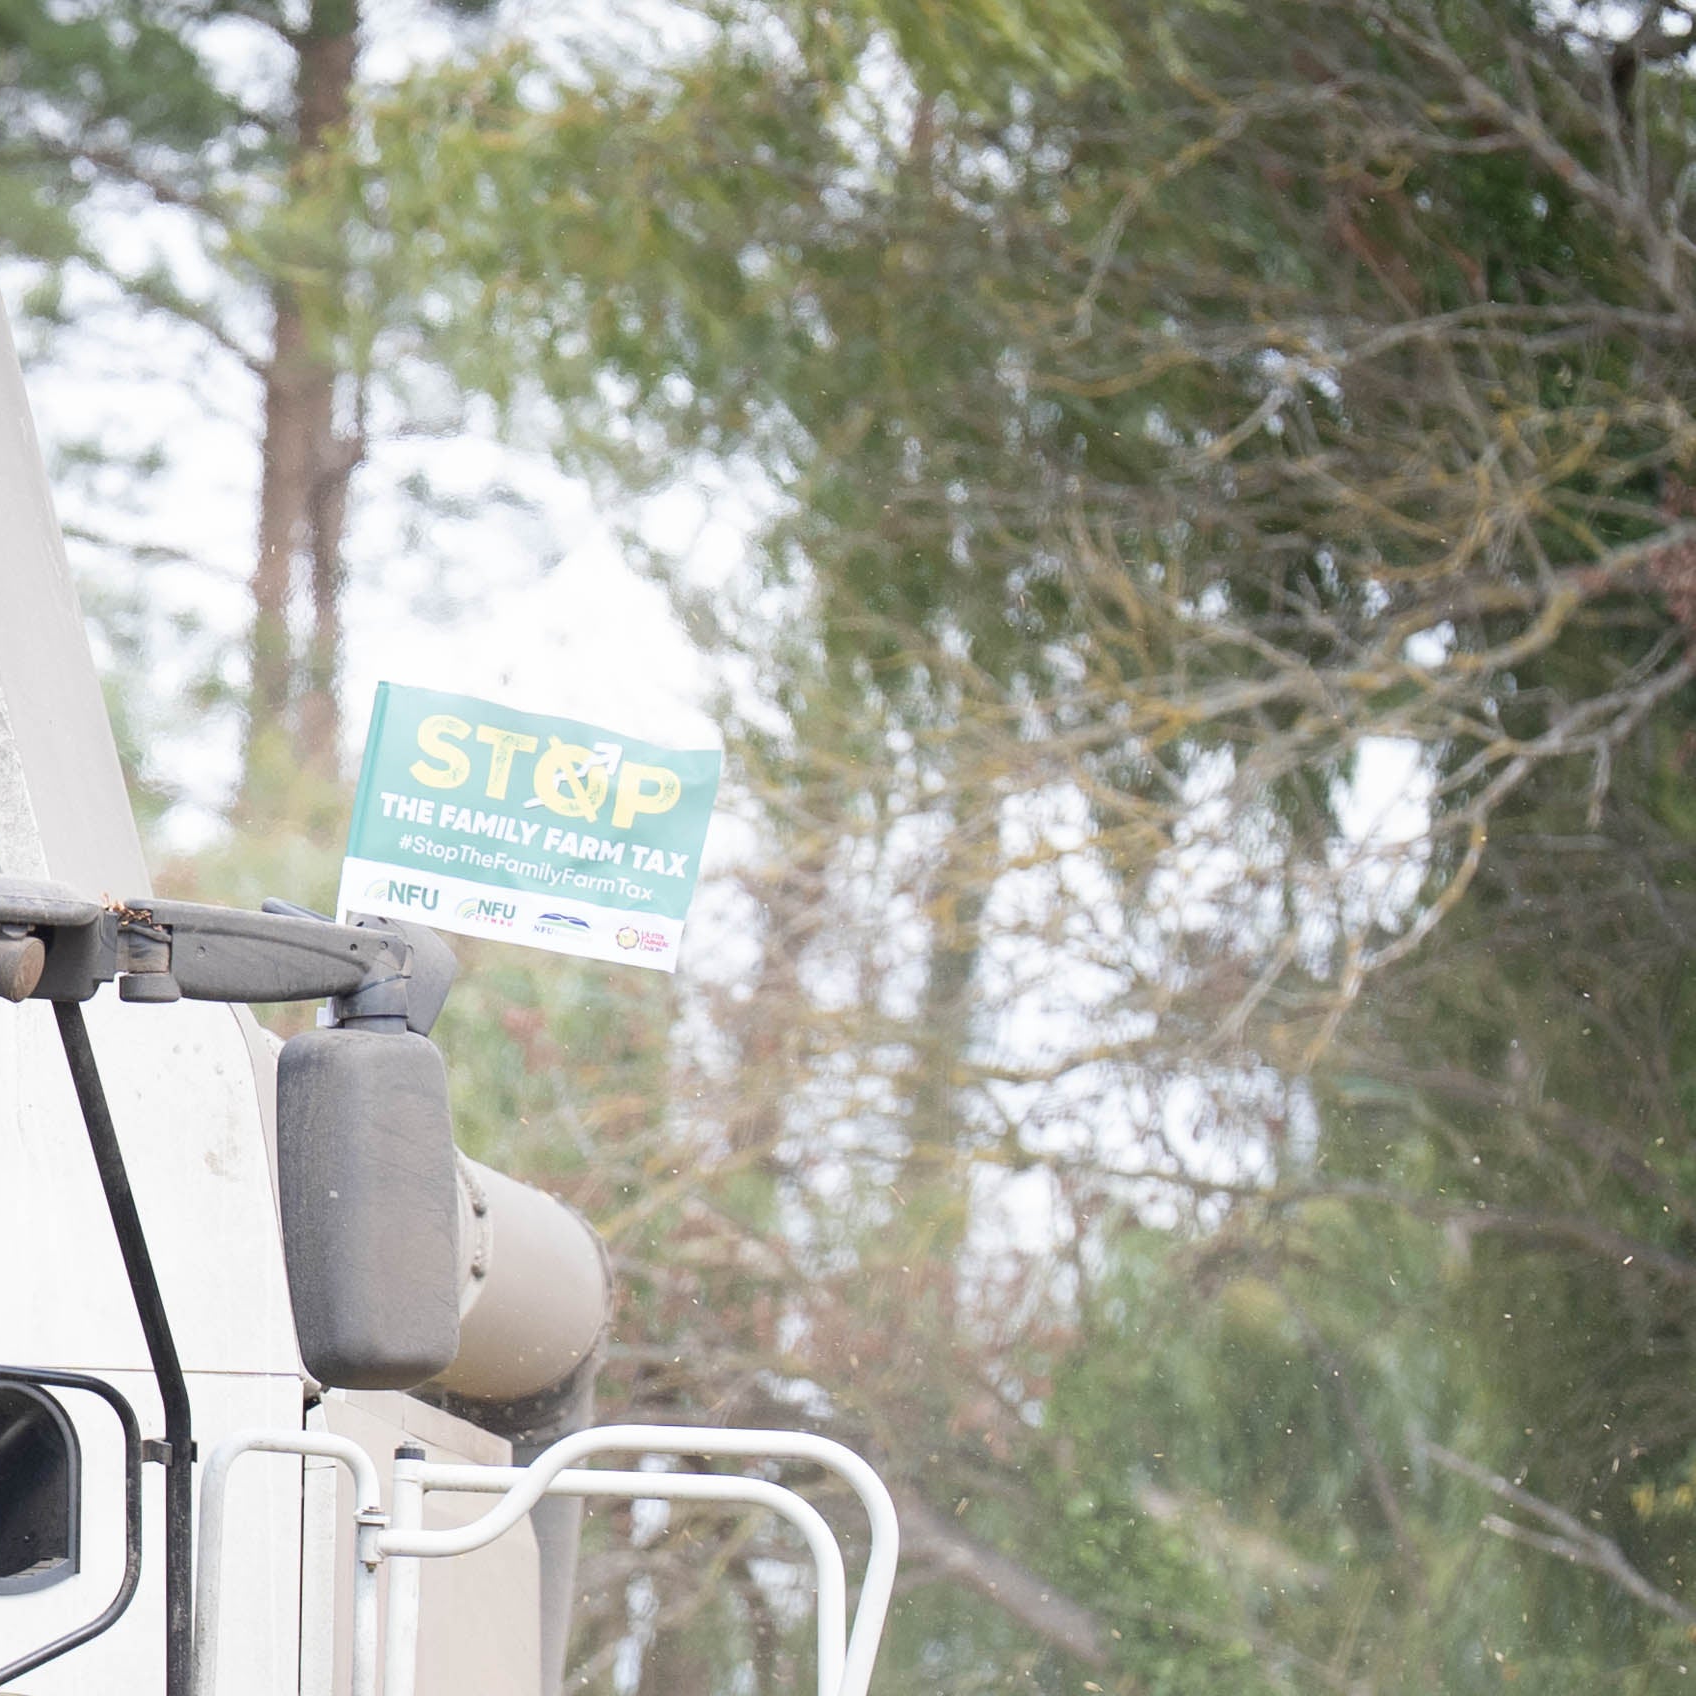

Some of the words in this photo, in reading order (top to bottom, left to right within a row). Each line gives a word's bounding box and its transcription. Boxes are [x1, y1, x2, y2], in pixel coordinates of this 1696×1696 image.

[409, 714, 682, 829] STOP
[380, 792, 435, 826] THE
[439, 804, 541, 847] FAMILY
[543, 826, 626, 866] FARM
[631, 845, 690, 879] TAX
[398, 833, 654, 902] #StopTheFamilyFarmTax
[387, 880, 440, 911] NFU
[476, 899, 517, 920] NFU
